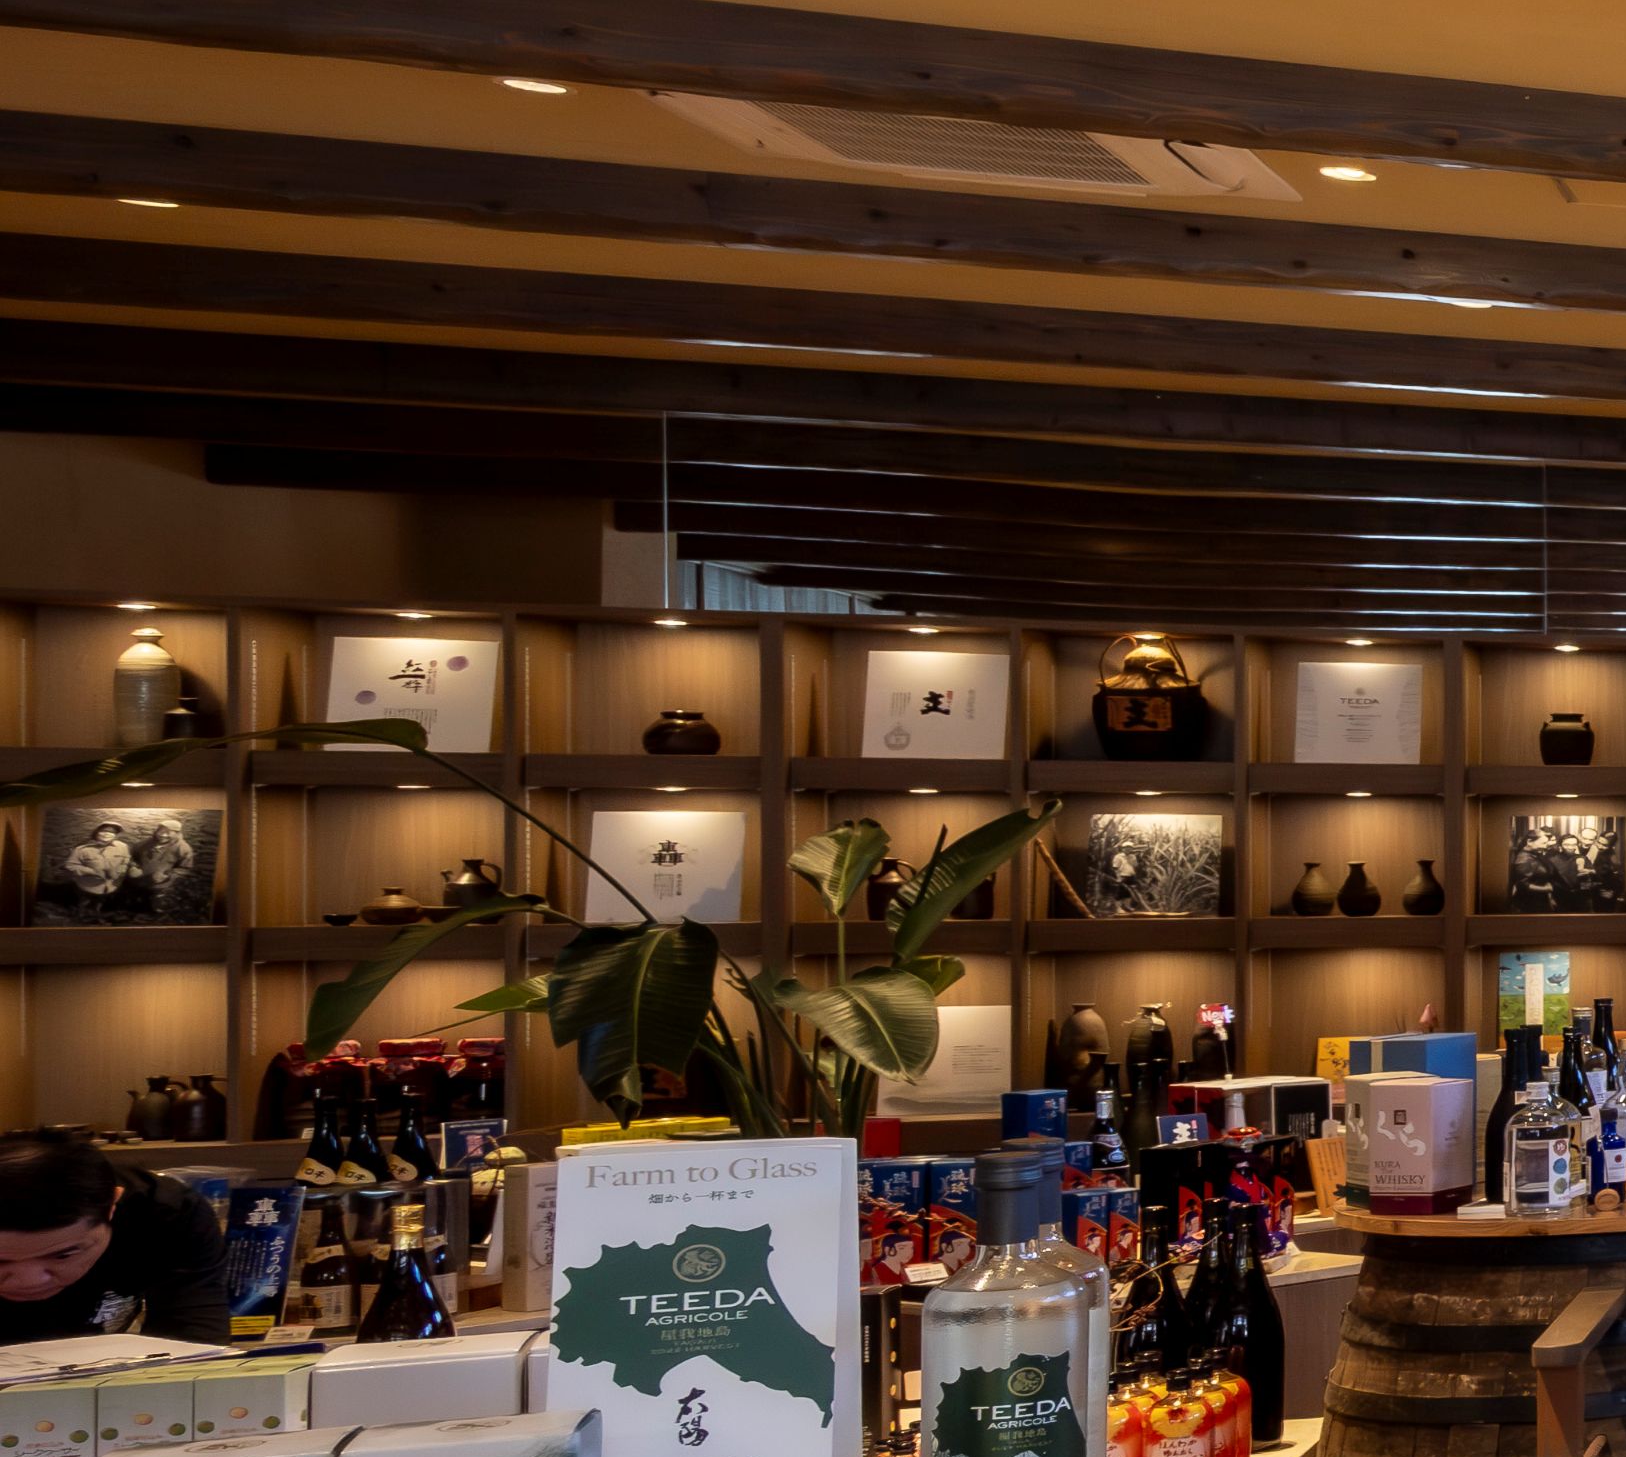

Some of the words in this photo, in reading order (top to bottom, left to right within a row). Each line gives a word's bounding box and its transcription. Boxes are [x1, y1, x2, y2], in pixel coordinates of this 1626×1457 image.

[586, 1164, 675, 1189] Farm
[688, 1165, 719, 1185] to
[728, 1157, 818, 1181] Glass
[1375, 1174, 1426, 1185] WHISKY
[648, 1189, 754, 1204] 畑から一杯まで
[619, 1287, 775, 1315] TEEDA
[645, 1310, 748, 1326] AGRICOLE
[971, 1397, 1071, 1421] TEEDA
[987, 1415, 1058, 1430] AGRICOLE
